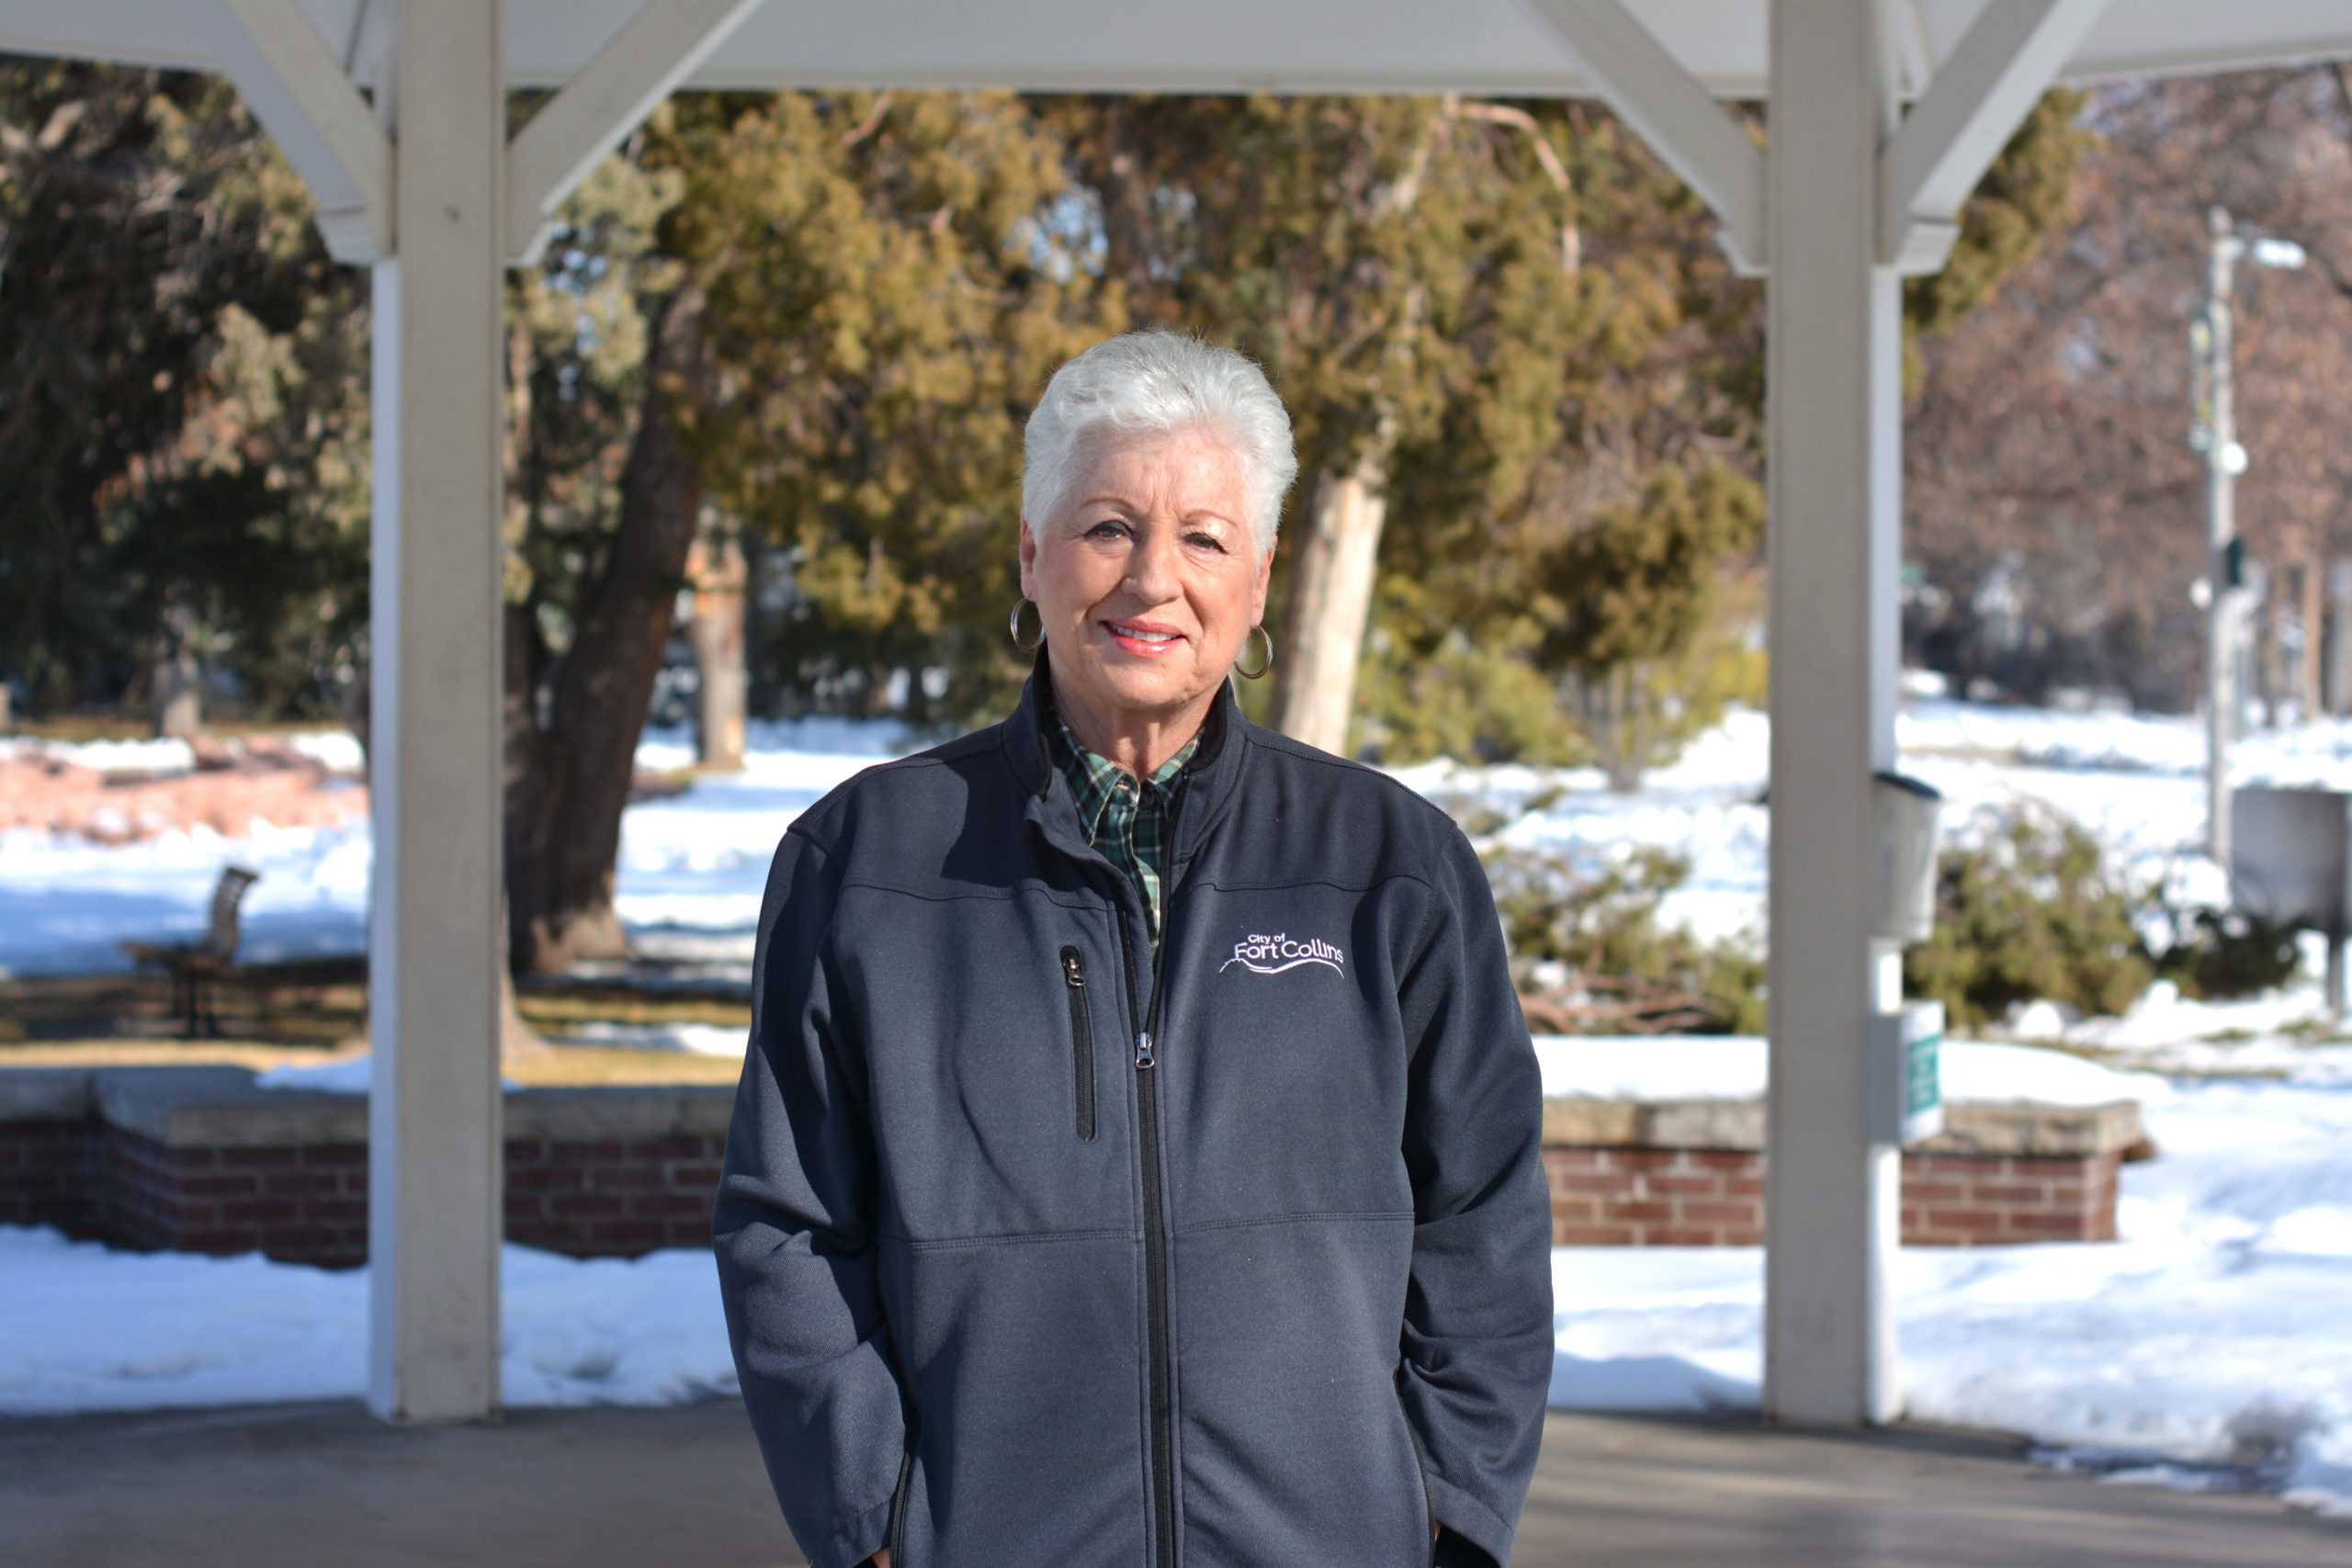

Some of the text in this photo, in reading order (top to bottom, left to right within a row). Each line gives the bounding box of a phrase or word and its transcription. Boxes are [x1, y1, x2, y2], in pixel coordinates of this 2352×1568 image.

[1248, 933, 1285, 943] City of
[1235, 938, 1344, 963] Fort Collins
